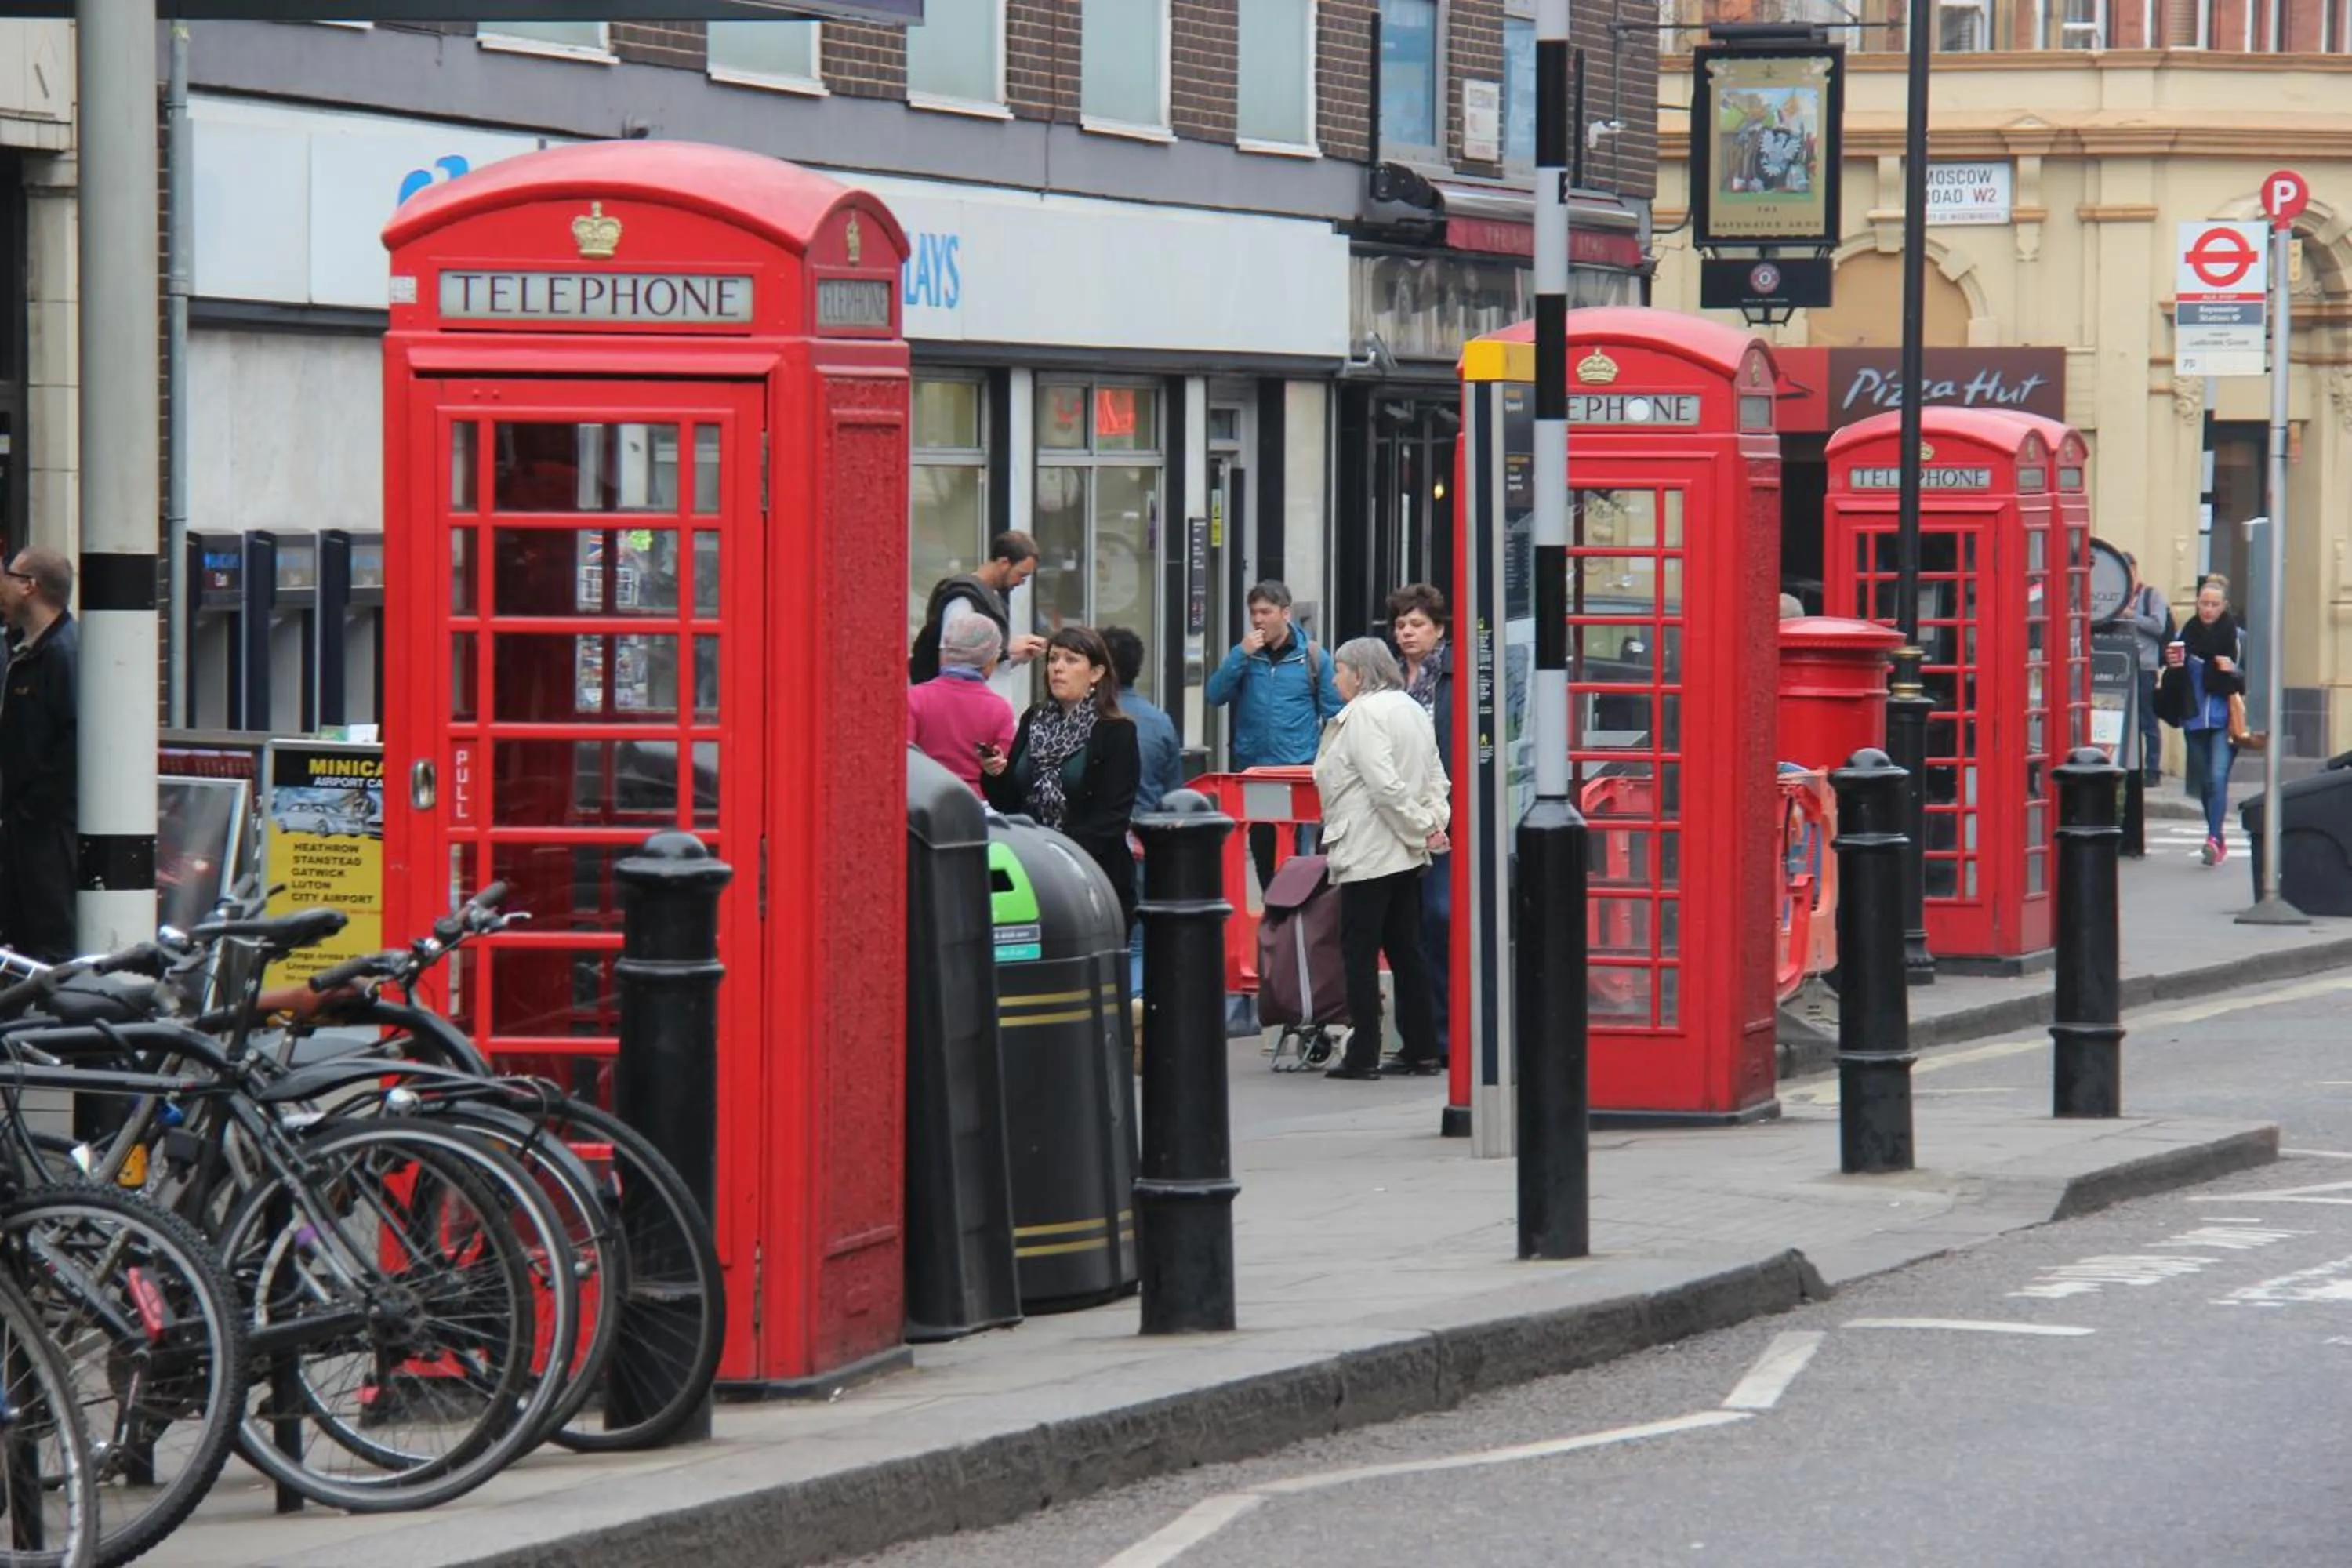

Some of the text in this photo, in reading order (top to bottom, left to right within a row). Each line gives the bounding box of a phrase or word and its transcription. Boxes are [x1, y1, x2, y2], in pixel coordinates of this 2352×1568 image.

[1926, 188, 1997, 203] OAD W2
[2273, 180, 2297, 215] P
[903, 232, 960, 309] LAYS
[452, 274, 739, 316] TELEPHONE
[1964, 367, 2050, 405] Hut
[308, 758, 383, 776] MINICA
[314, 776, 383, 788] AIRPORT CA
[456, 750, 470, 818] PULL
[293, 843, 360, 853] HEATHROW
[292, 855, 362, 866] STANSTEAD
[292, 868, 346, 877] GATWICK
[291, 880, 332, 890] LUTON
[291, 893, 374, 903] CITY AIRPORT
